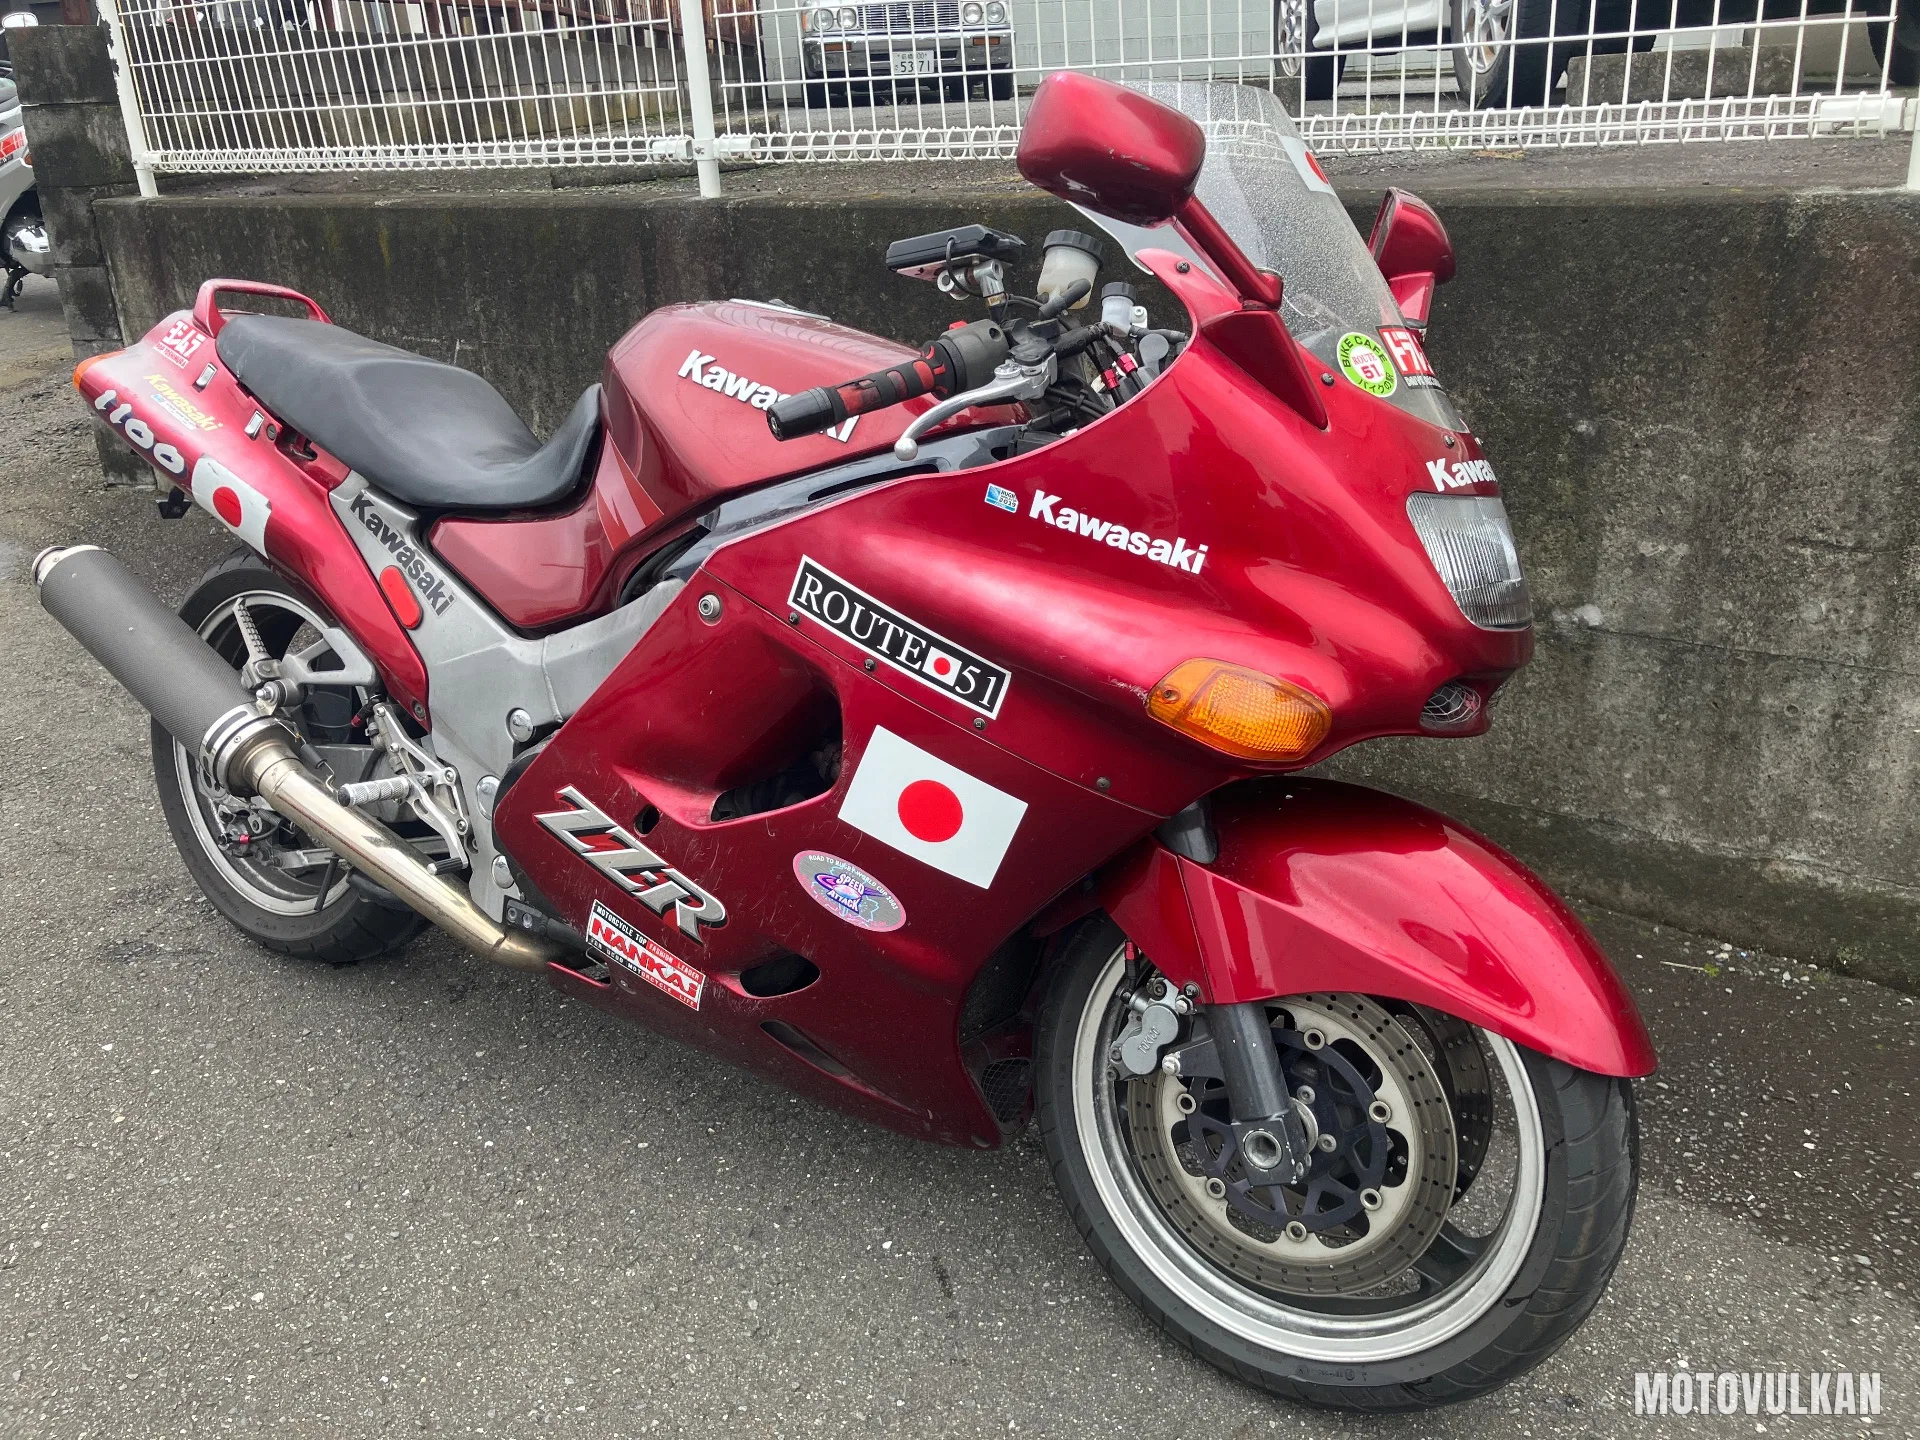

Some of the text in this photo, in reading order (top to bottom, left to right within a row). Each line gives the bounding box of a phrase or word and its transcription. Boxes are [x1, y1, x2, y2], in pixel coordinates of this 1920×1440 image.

[1341, 335, 1388, 368] BIKE CAFE
[1352, 352, 1377, 365] ROUTE
[1361, 364, 1381, 379] 51
[143, 374, 224, 432] Kawasaki
[678, 349, 860, 444] Kawai
[94, 389, 187, 476] 1100
[1028, 489, 1209, 575] Kawasaki
[350, 493, 455, 617] Kawasaki
[797, 572, 997, 708] ROUTE 51
[827, 889, 860, 912] ATTACK
[836, 873, 865, 896] SPEED
[876, 886, 888, 896] CUP
[597, 905, 700, 981] MOTORCYCLE TOP FASHION LEADER
[628, 962, 672, 994] MOTORCYCLE
[679, 993, 695, 1007] LIFE
[1138, 1026, 1161, 1054] TOKICO
